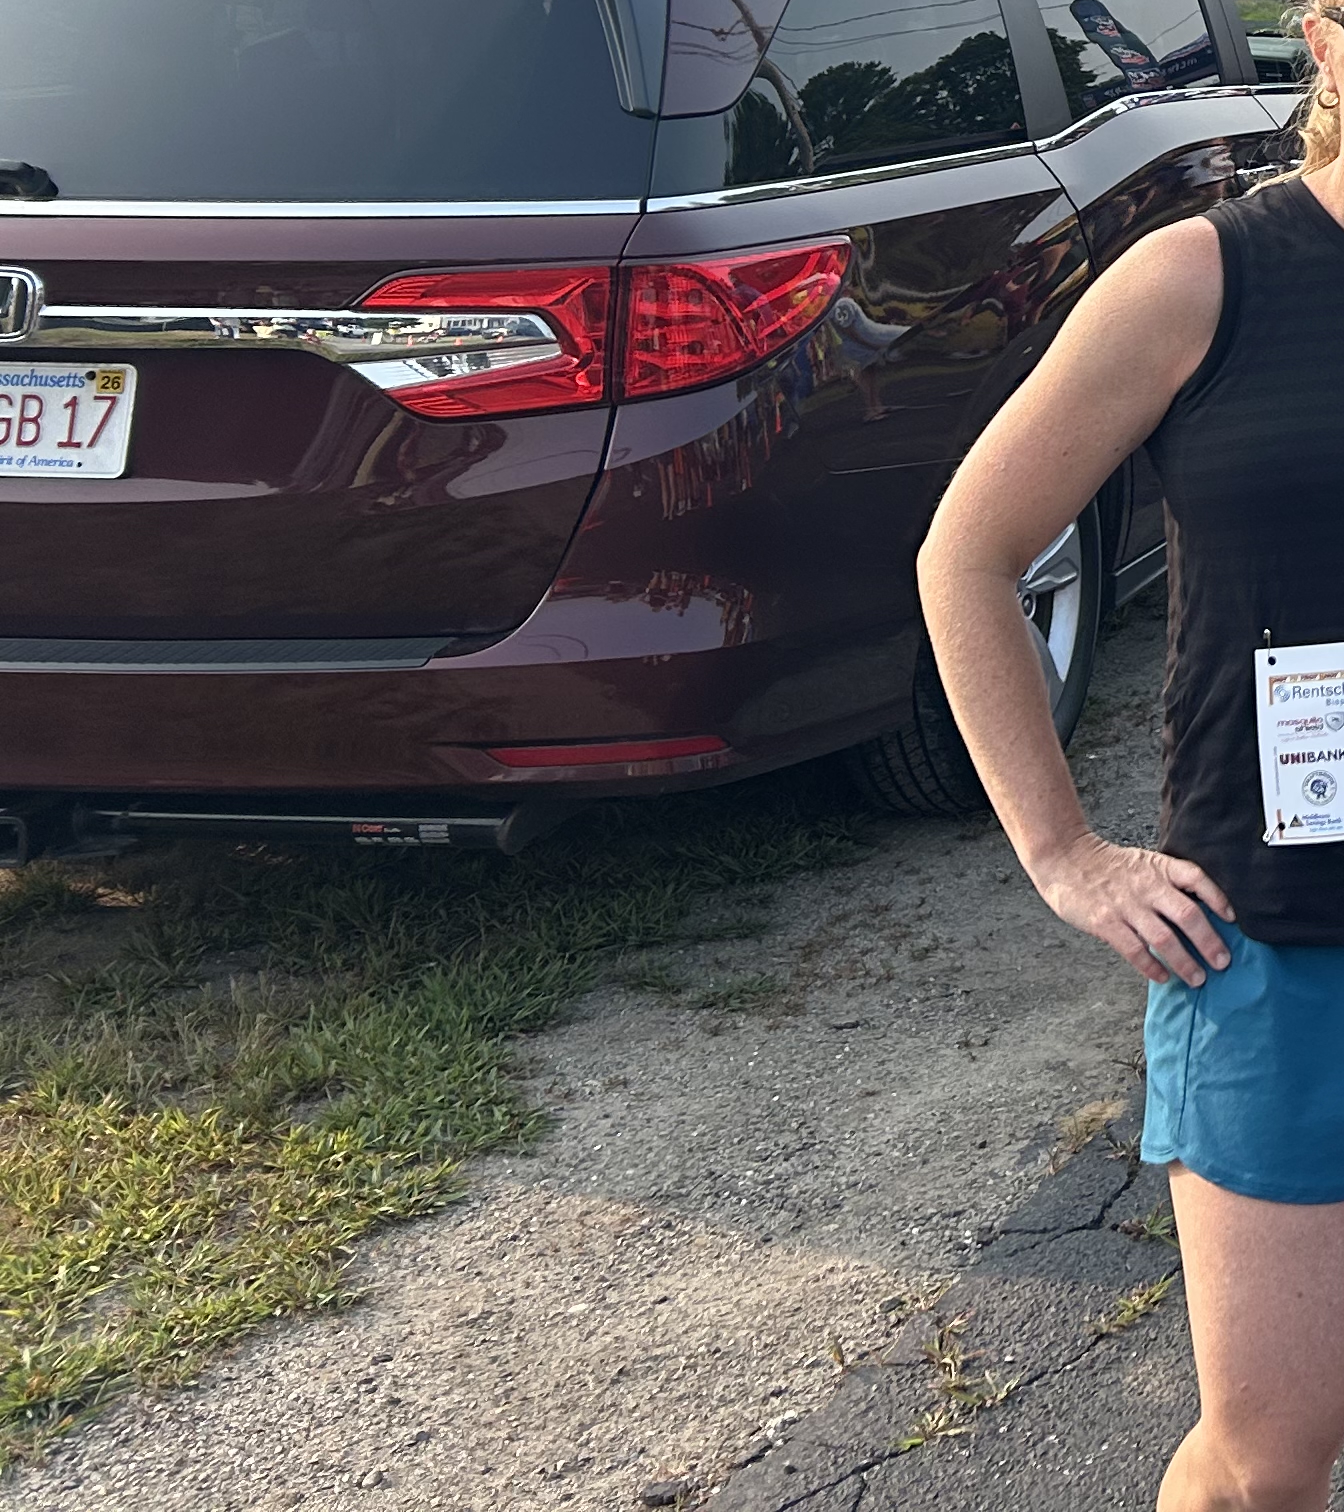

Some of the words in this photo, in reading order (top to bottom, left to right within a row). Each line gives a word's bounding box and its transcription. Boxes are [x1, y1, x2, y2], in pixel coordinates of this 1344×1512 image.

[100, 375, 121, 390] 26
[57, 395, 117, 449] 17
[16, 454, 28, 468] of
[28, 456, 75, 468] America
